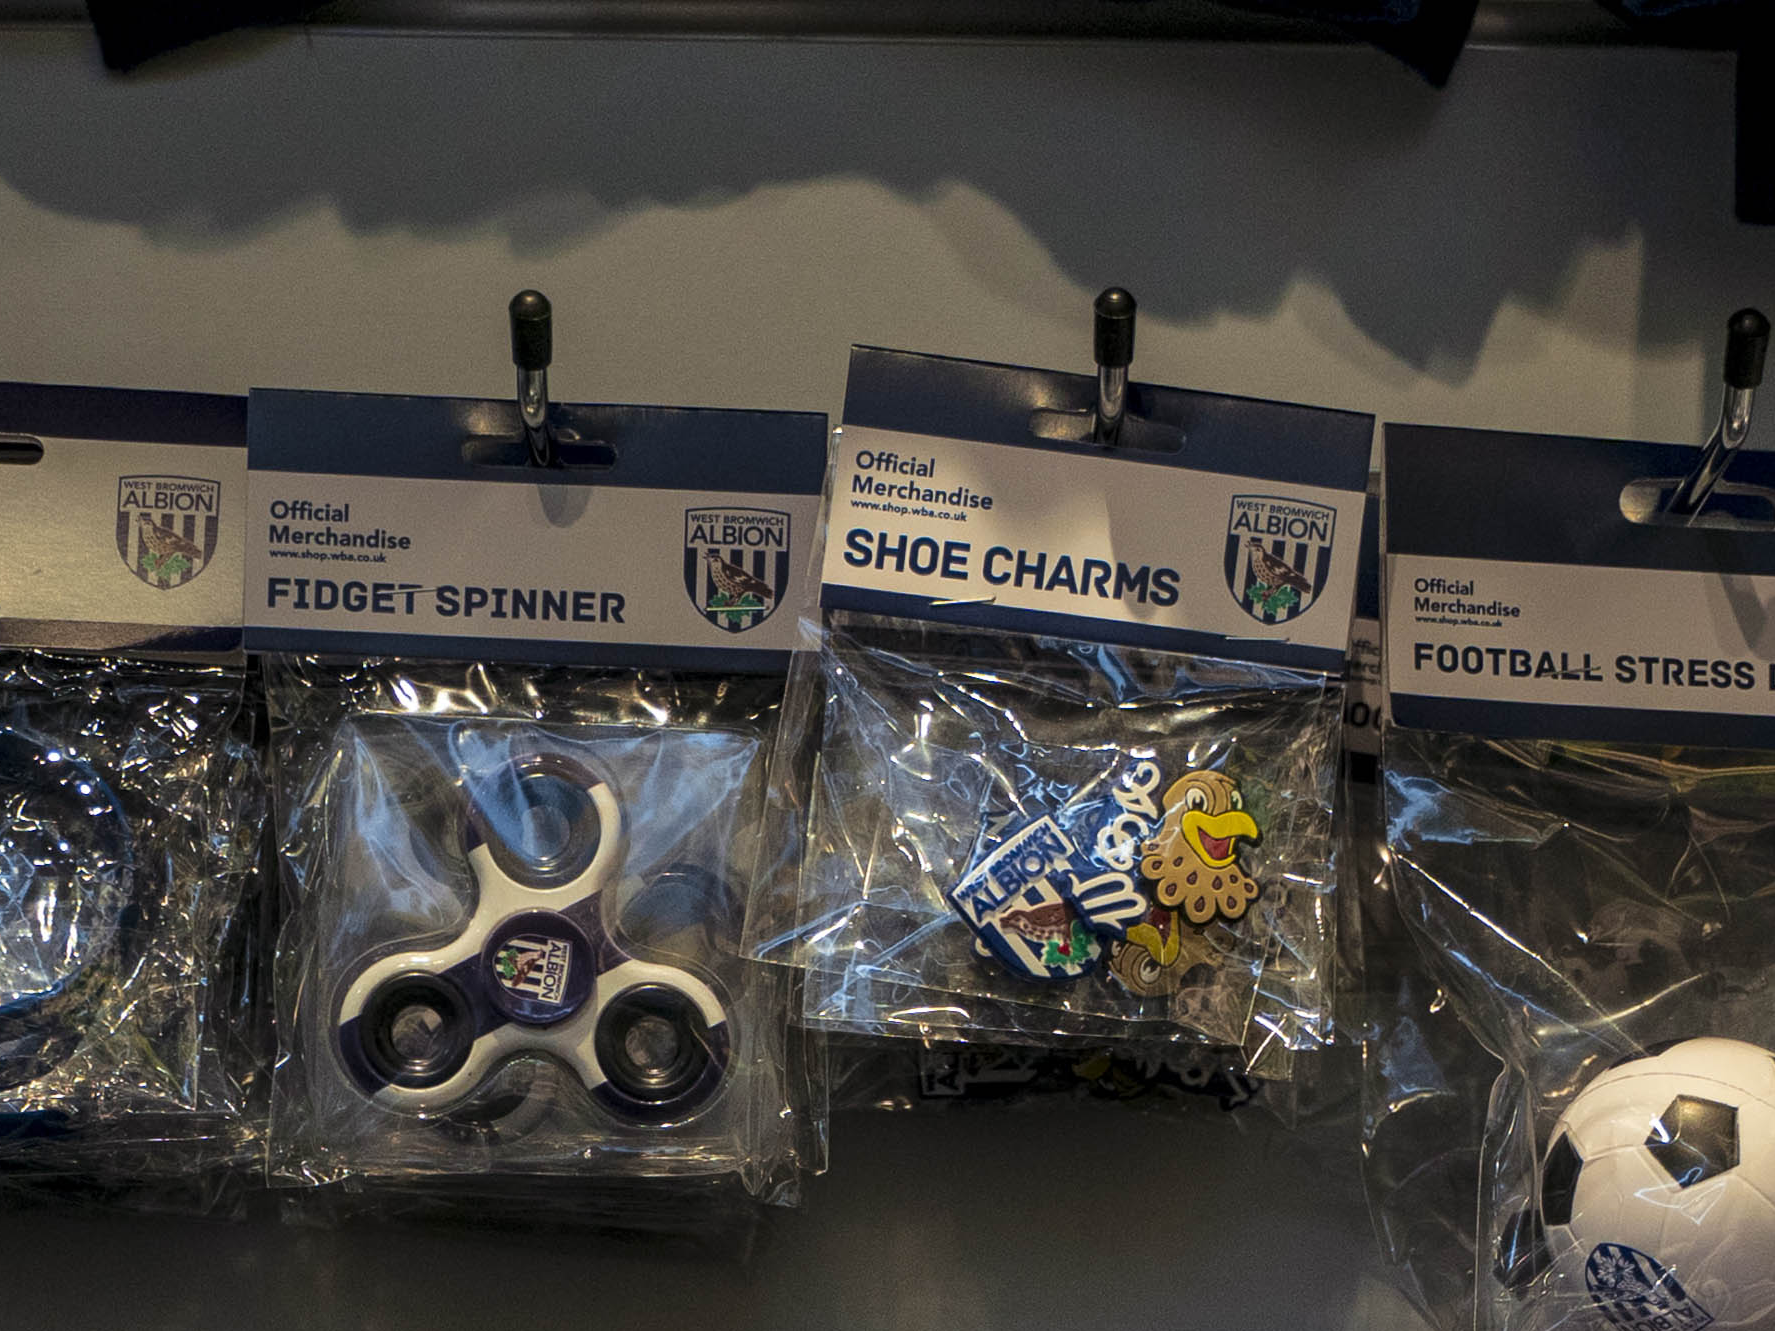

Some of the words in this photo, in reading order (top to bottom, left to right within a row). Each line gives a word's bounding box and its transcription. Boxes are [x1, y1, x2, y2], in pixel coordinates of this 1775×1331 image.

[855, 450, 935, 478] Official
[122, 490, 213, 512] ALBION
[852, 475, 993, 510] Merchandise
[270, 500, 349, 522] Official
[690, 513, 721, 525] WEST
[724, 515, 785, 527] BROMWICH
[1237, 499, 1266, 513] WEST
[1269, 504, 1330, 521] BROMWICH
[269, 525, 411, 550] Merchandise
[689, 525, 784, 547] ALBION
[1233, 513, 1328, 541] ALBION
[843, 528, 970, 580] SHOE
[982, 546, 1181, 607] CHARMS
[268, 577, 421, 615] FIDGET
[435, 585, 625, 623] SPINNER
[1414, 578, 1474, 597] Official
[1414, 597, 1521, 618] Merchandise
[1413, 642, 1603, 682] FOOTBALL
[1614, 657, 1755, 690] STRESS
[542, 939, 561, 1002] ALBION
